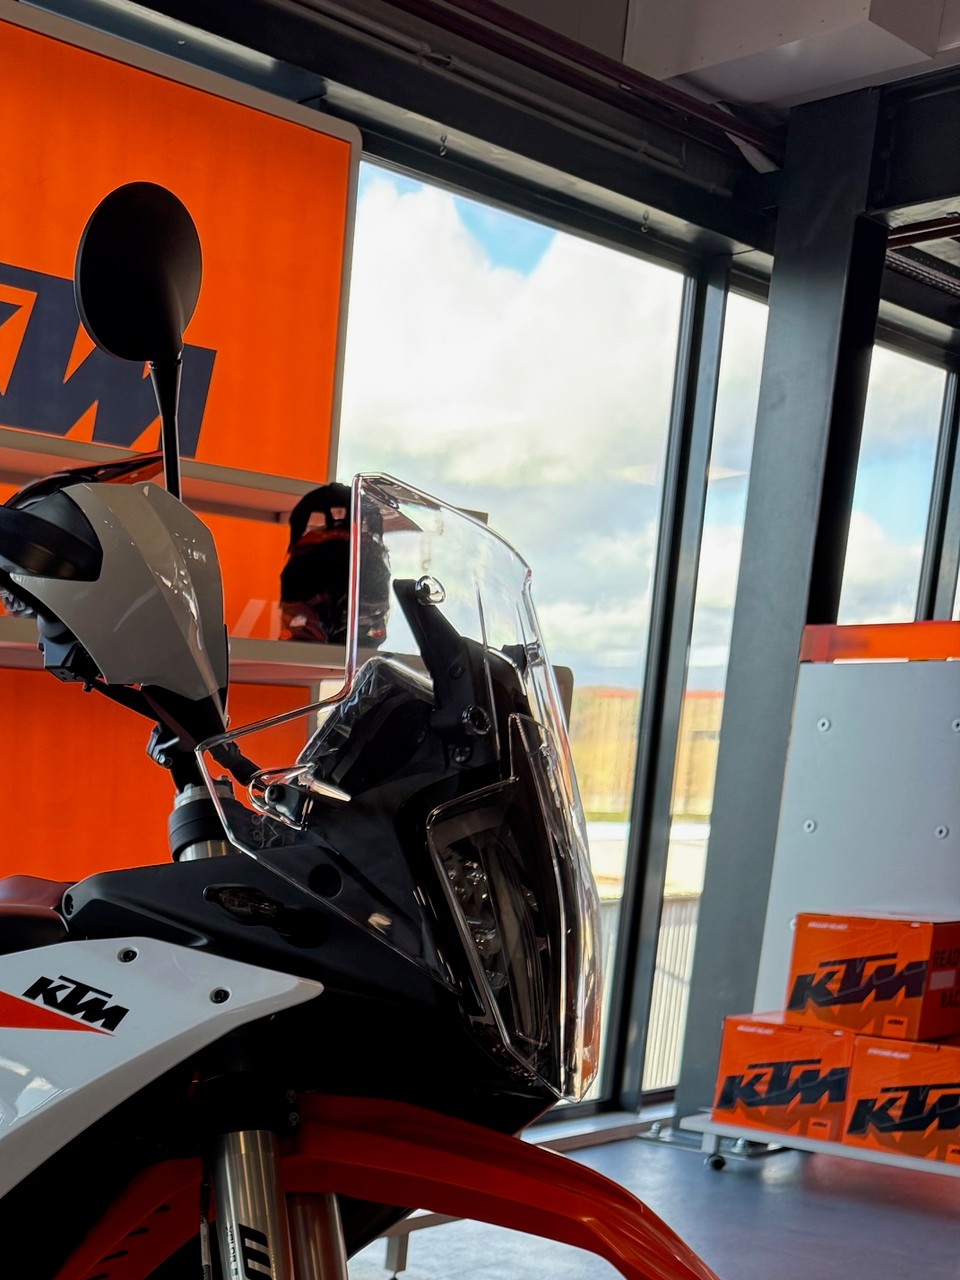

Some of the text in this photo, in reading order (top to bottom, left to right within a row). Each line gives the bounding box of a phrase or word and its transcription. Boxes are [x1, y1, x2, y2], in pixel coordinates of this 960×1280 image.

[22, 975, 129, 1032] KTM
[788, 952, 928, 1010] KTM
[716, 1058, 850, 1110] KTM
